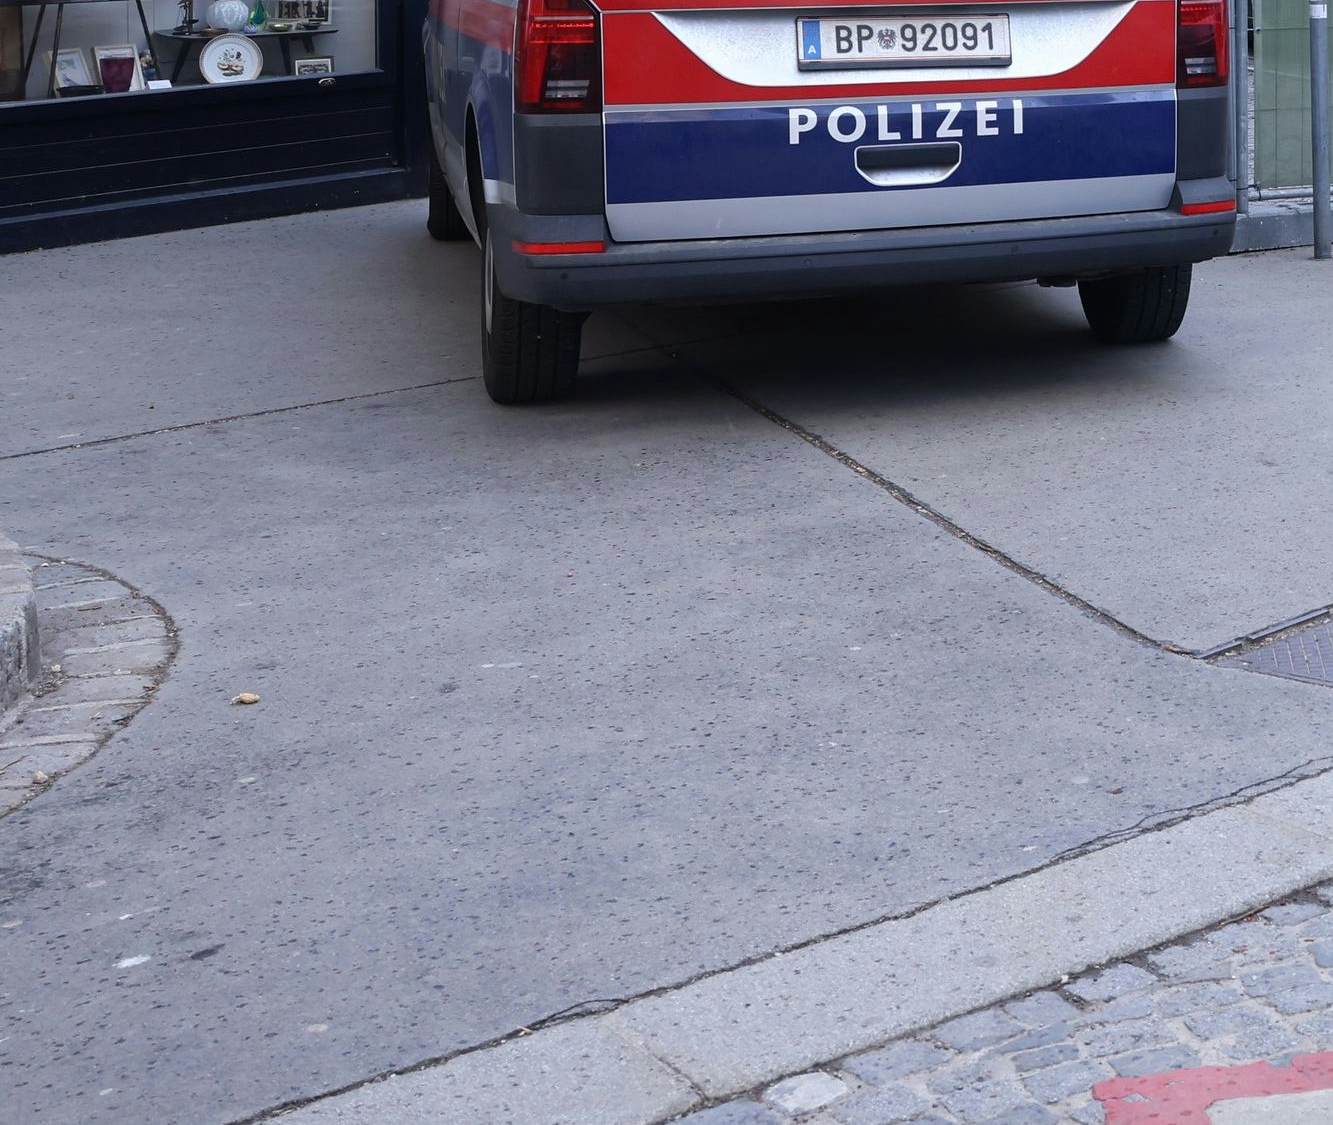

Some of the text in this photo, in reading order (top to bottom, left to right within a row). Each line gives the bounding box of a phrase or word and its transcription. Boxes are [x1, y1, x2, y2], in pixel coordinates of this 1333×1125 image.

[834, 23, 874, 54] BP
[900, 22, 994, 52] 92091
[788, 99, 1024, 145] POLIZEI
